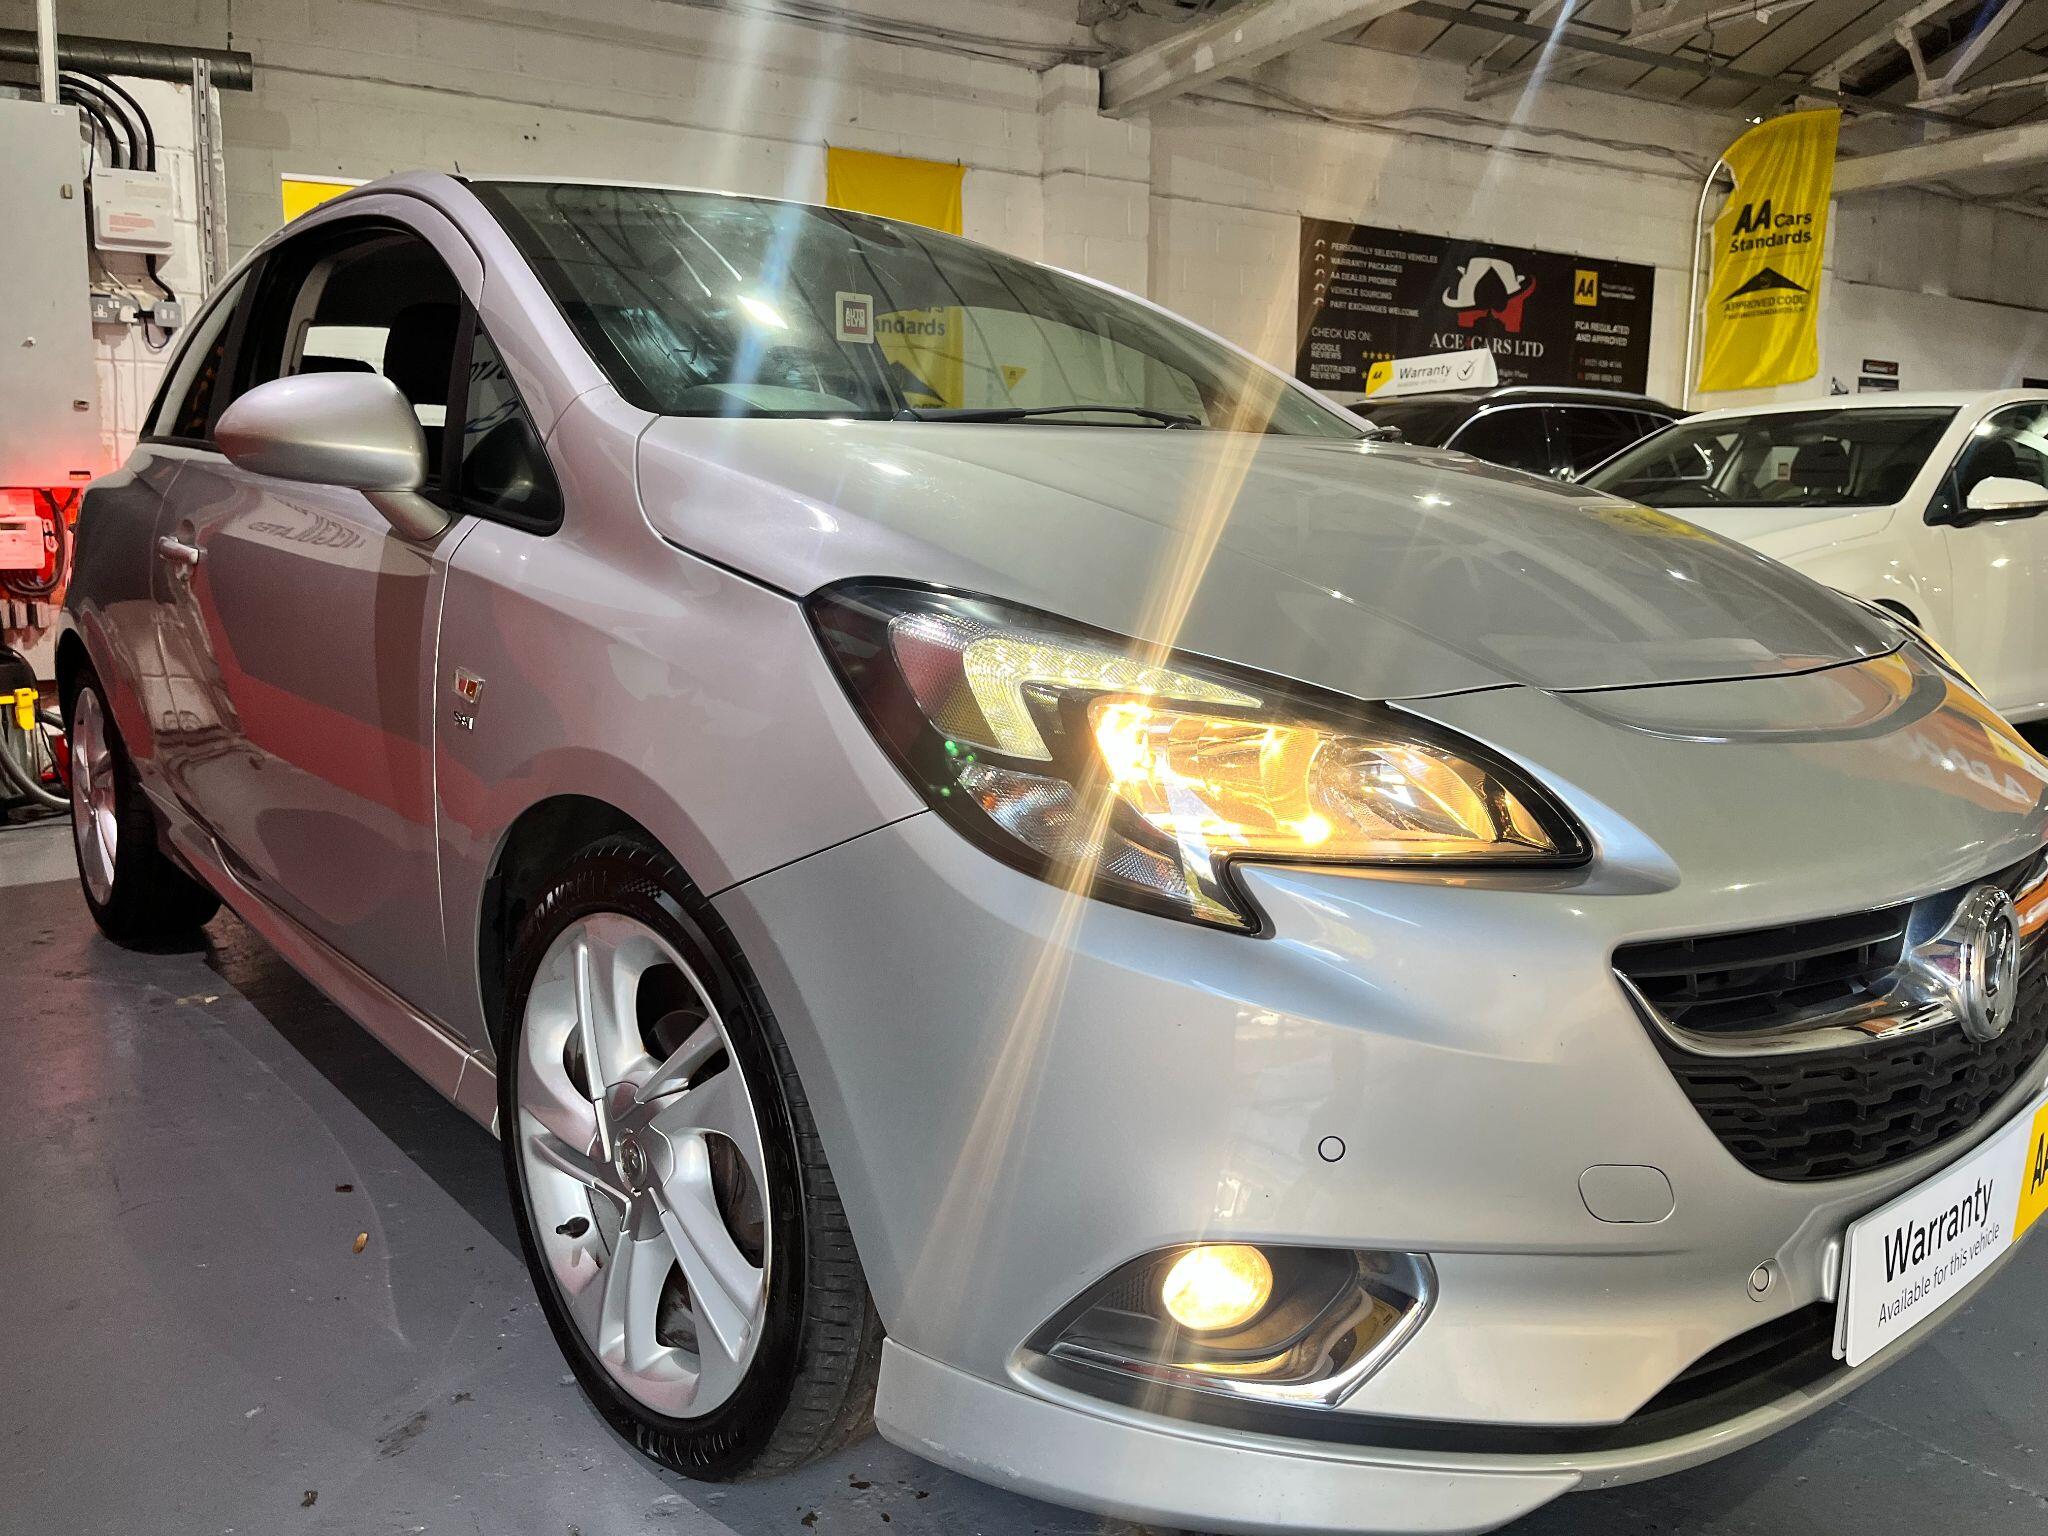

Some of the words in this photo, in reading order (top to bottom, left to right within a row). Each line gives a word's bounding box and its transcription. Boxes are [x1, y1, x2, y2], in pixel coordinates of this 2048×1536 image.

[1732, 199, 1771, 235] AA
[1774, 213, 1812, 227] Cars
[1729, 230, 1812, 253] Standards
[1576, 278, 1594, 297] AA
[846, 307, 865, 319] AUTO
[1311, 327, 1342, 339] CHECK
[1344, 330, 1356, 340] US
[1311, 342, 1340, 352] GOOGLE
[1311, 351, 1341, 360] REVIEWS
[1515, 340, 1544, 357] LTD
[1400, 364, 1451, 379] Warranty
[1883, 1177, 1993, 1284] Warranty
[1878, 1276, 1931, 1328] Available
[1933, 1263, 1948, 1290] for
[1949, 1250, 1967, 1277] this
[1969, 1221, 2000, 1261] vehicle
